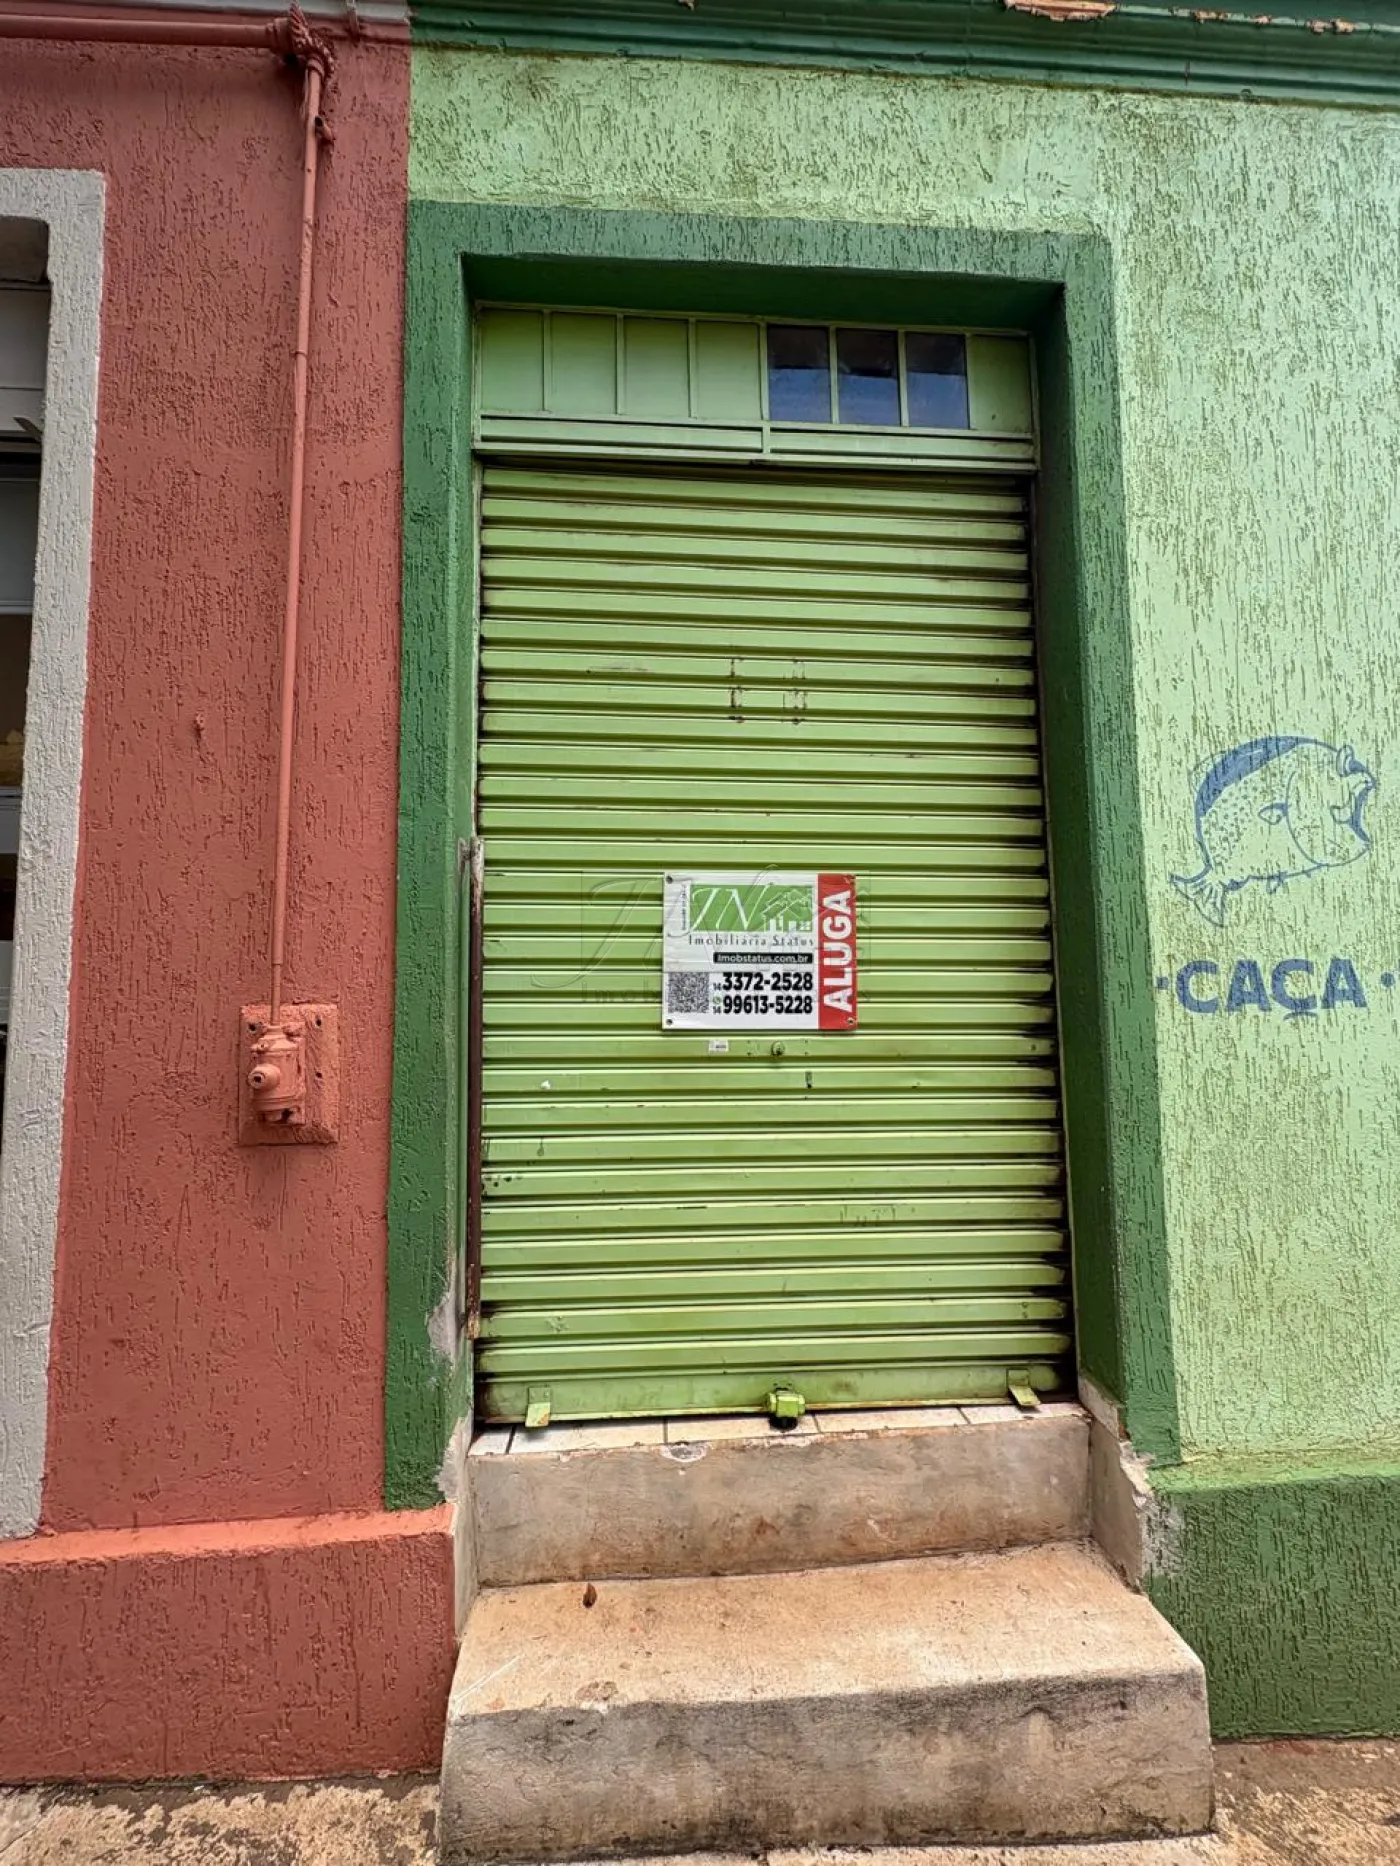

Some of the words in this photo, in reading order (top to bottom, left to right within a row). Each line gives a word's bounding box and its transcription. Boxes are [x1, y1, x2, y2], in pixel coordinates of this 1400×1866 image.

[772, 935, 814, 947] Status
[823, 890, 853, 1013] ALUGA
[722, 972, 813, 991] 3372-2528
[1176, 956, 1368, 1020] CAÇA
[723, 995, 813, 1014] 99613-5228
